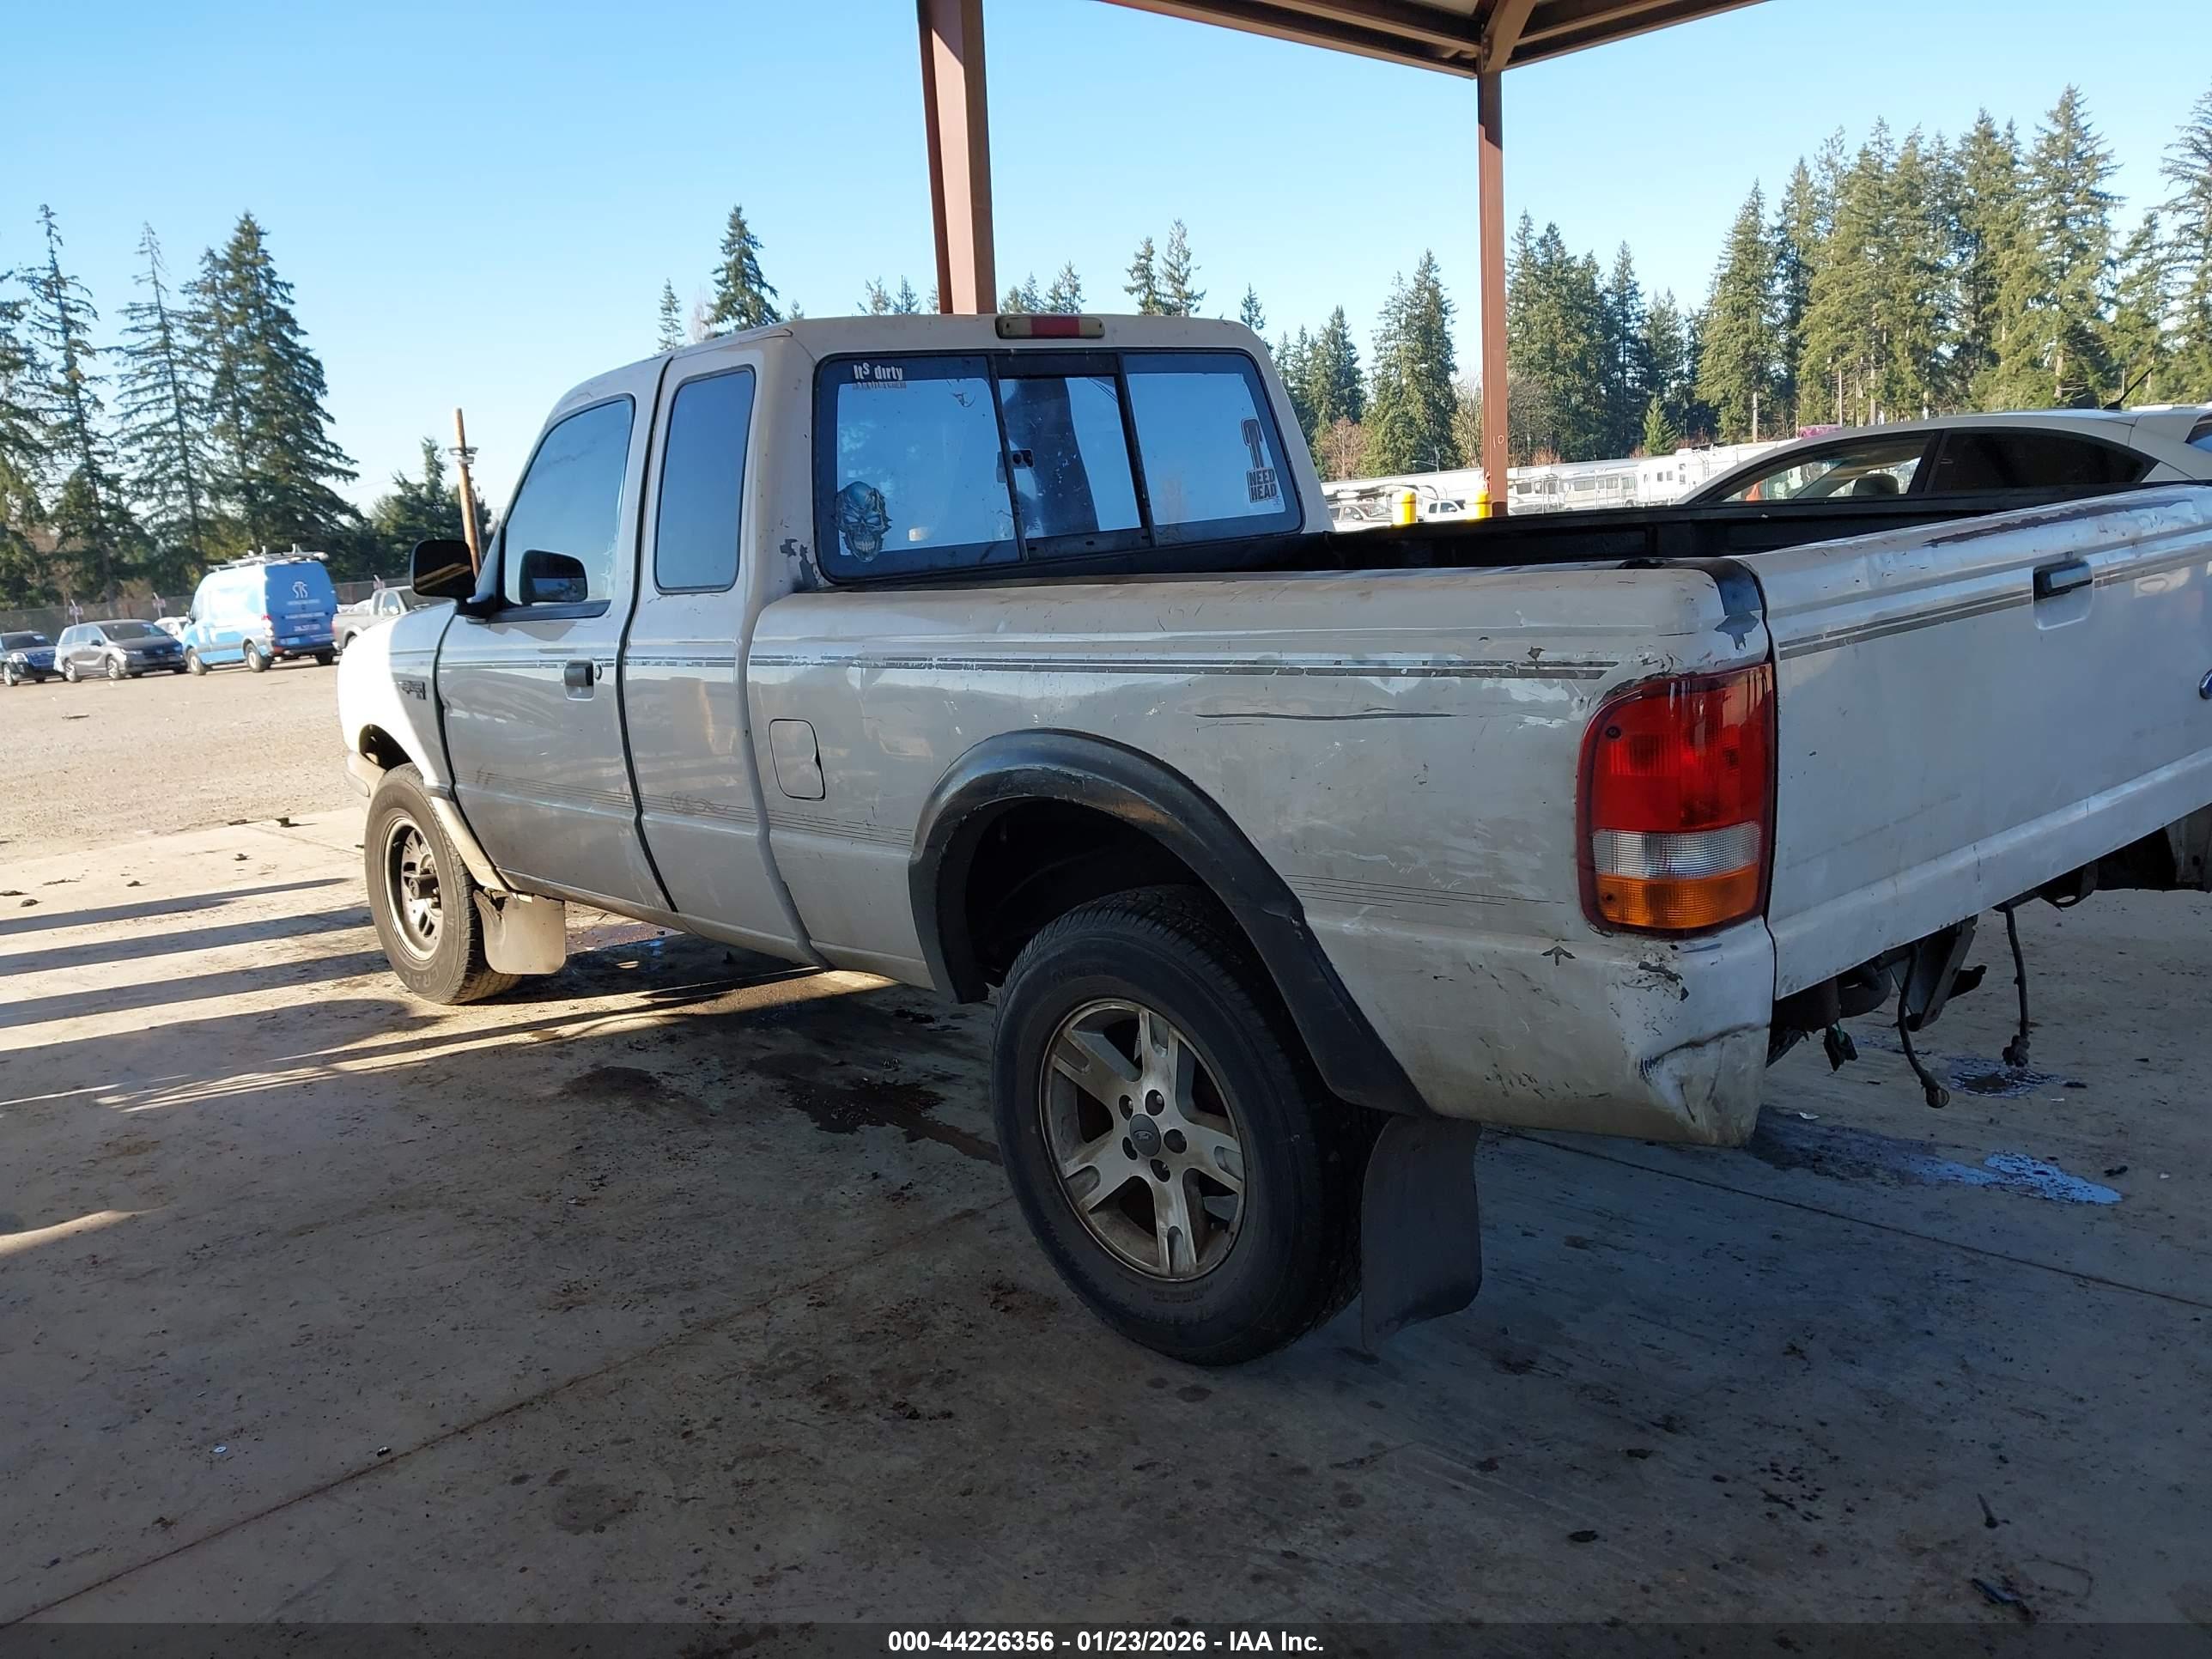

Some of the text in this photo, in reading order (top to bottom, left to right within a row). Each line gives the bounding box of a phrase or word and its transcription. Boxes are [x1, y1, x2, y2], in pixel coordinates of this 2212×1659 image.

[874, 365, 903, 380] dirty
[1249, 470, 1275, 484] NEED
[1251, 484, 1278, 501] HEAD
